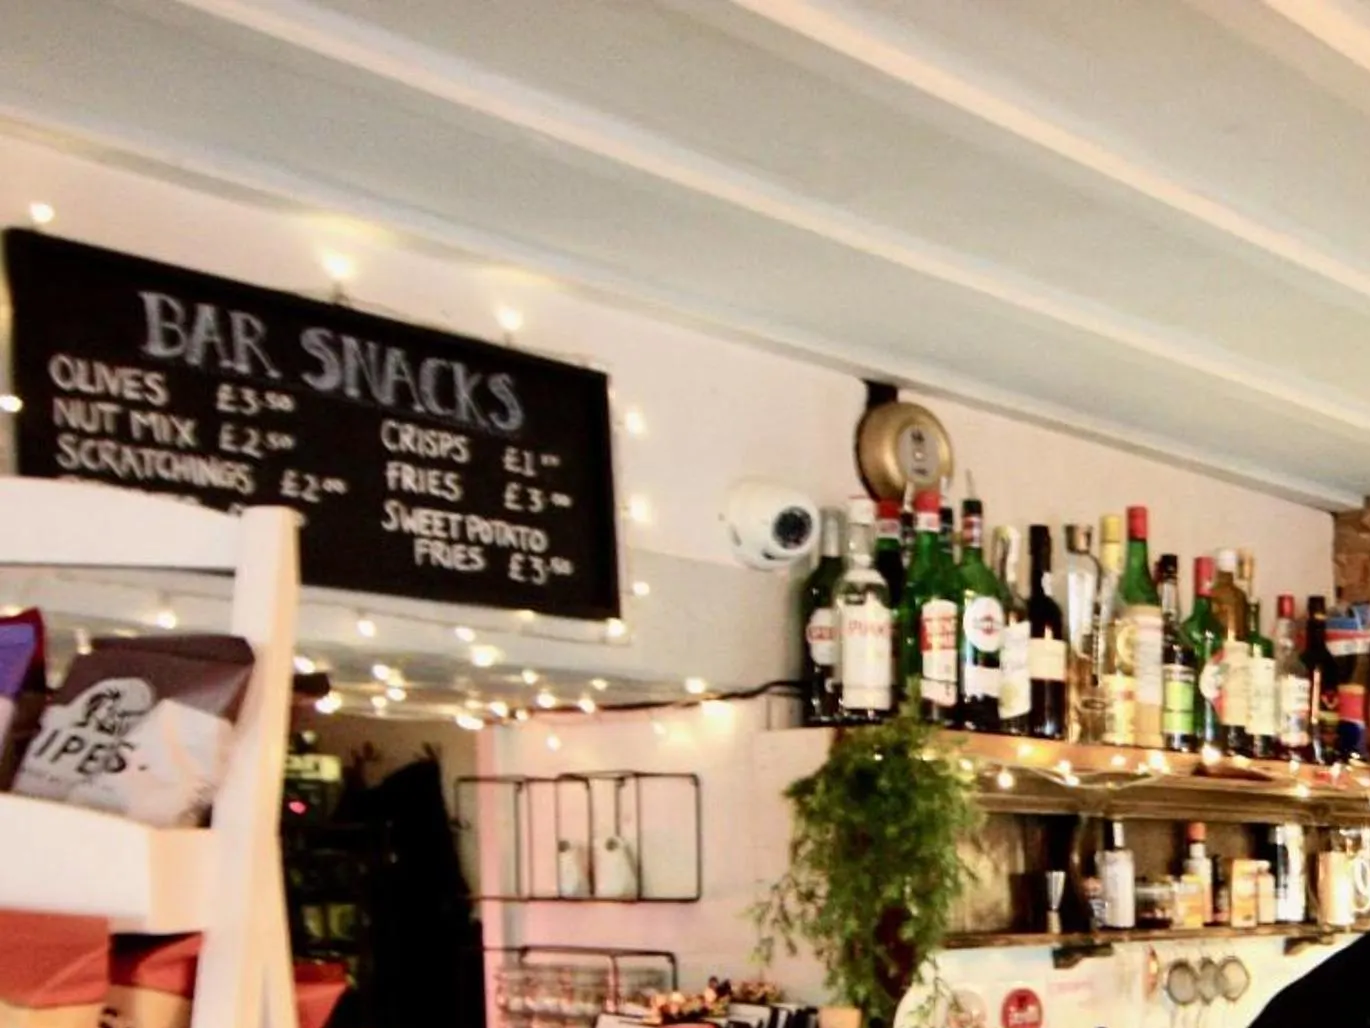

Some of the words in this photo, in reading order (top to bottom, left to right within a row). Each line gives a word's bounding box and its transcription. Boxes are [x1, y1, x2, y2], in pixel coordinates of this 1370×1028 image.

[48, 352, 169, 407] OLIVES
[139, 290, 283, 379] BAR
[300, 326, 525, 432] SNACKS
[53, 397, 122, 434] NUT
[129, 408, 198, 448] MIX
[380, 418, 471, 464] CRISPS
[56, 432, 256, 496] SCRATCHINGS
[385, 460, 464, 502] FRIES
[381, 499, 464, 541] SWEET
[412, 537, 487, 571] FRIES
